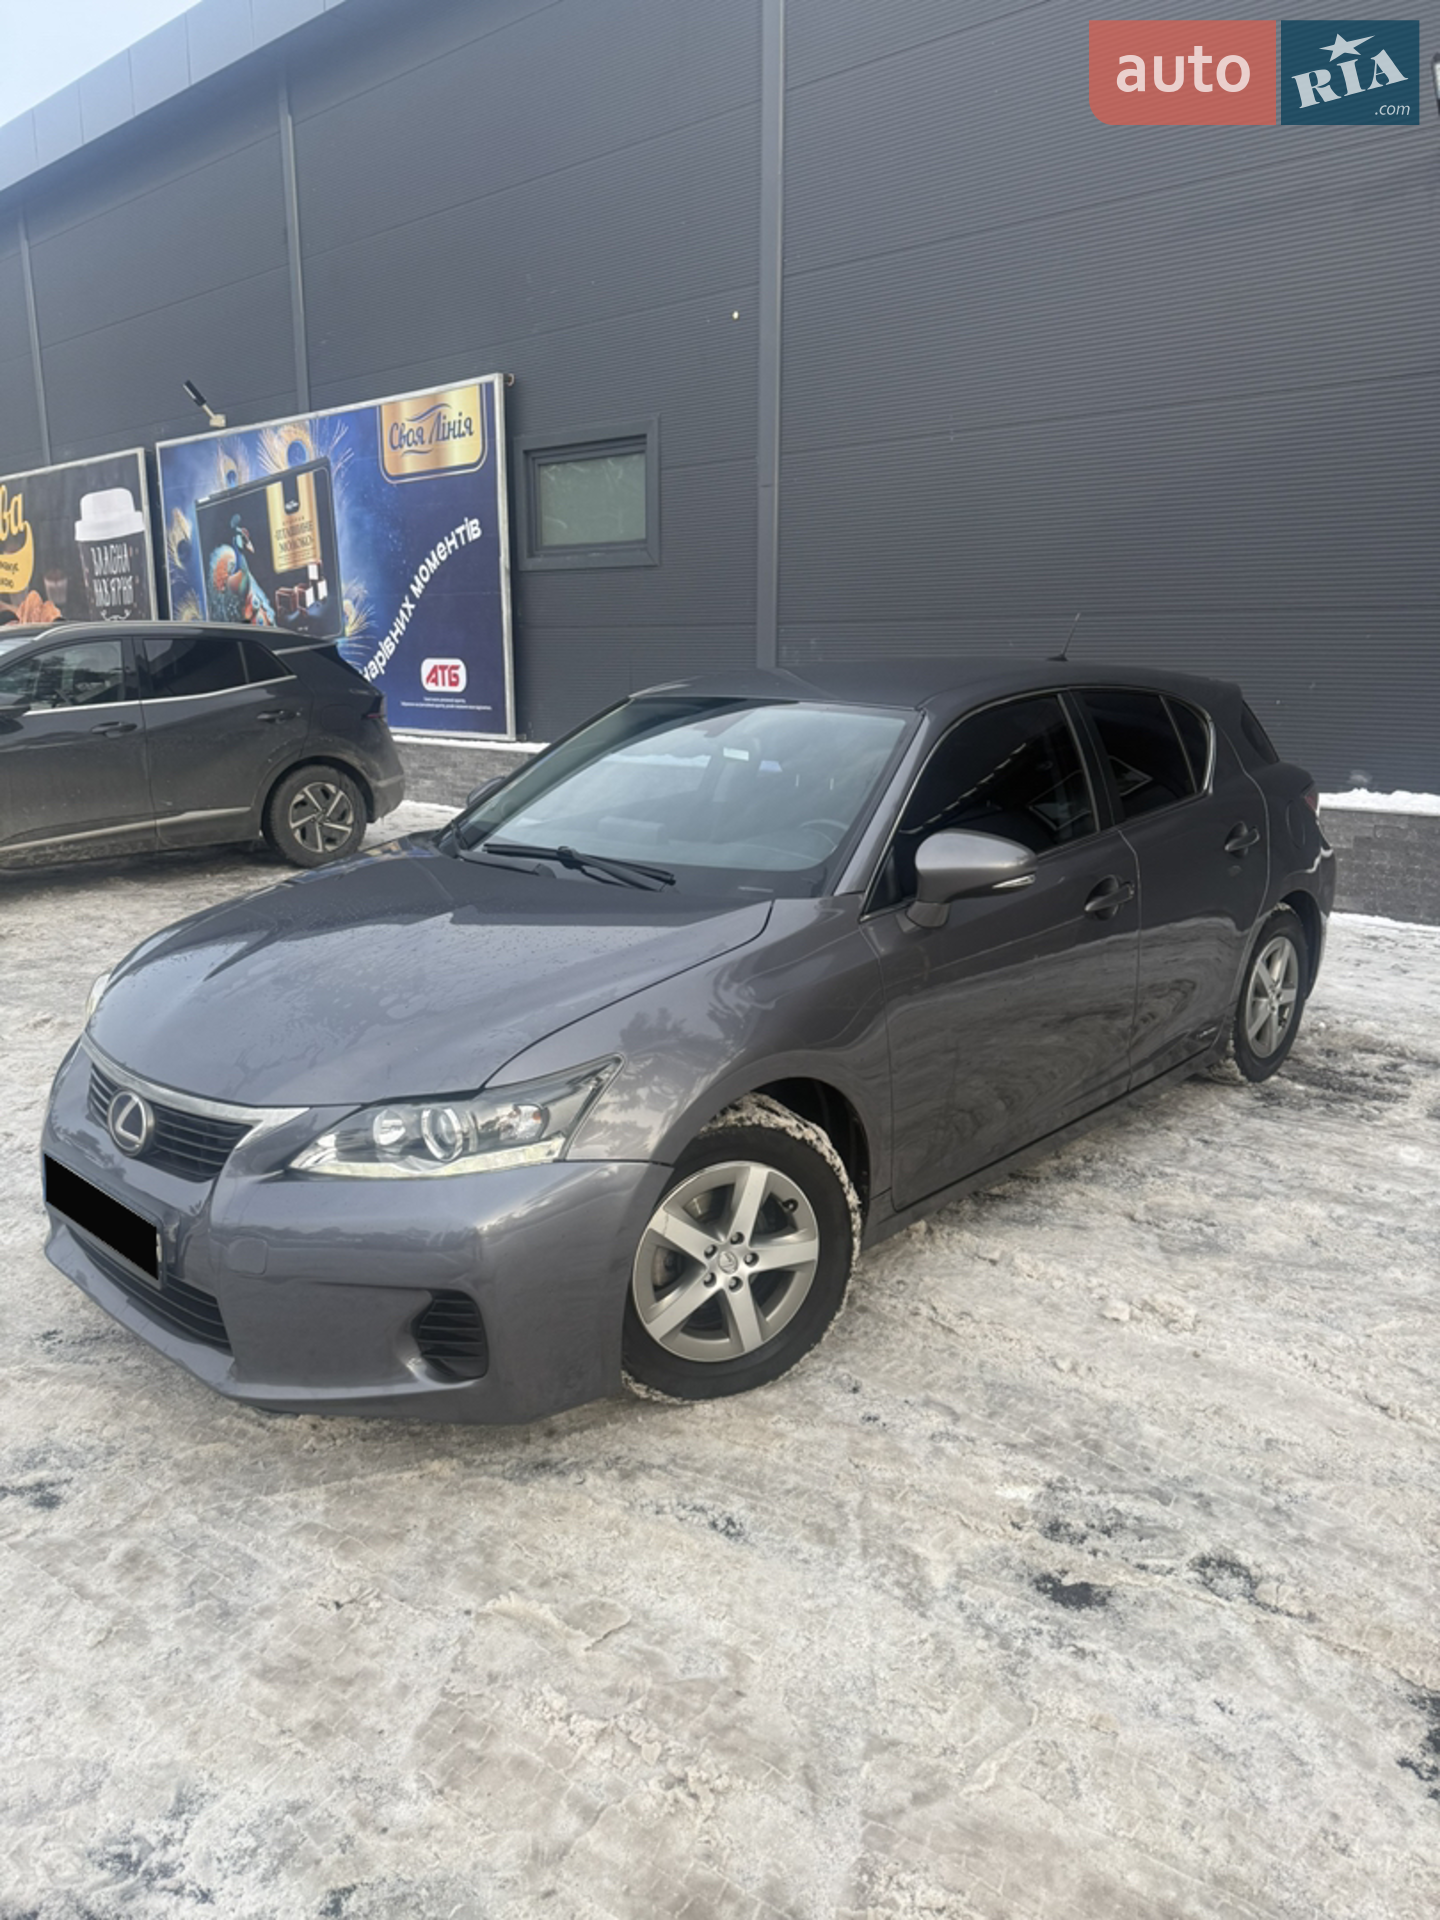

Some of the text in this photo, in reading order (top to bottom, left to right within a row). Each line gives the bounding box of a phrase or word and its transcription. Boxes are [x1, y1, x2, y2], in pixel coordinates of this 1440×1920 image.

[389, 411, 475, 450] Своя Лінія
[409, 517, 482, 598] моментів
[426, 664, 461, 687] АТБ
